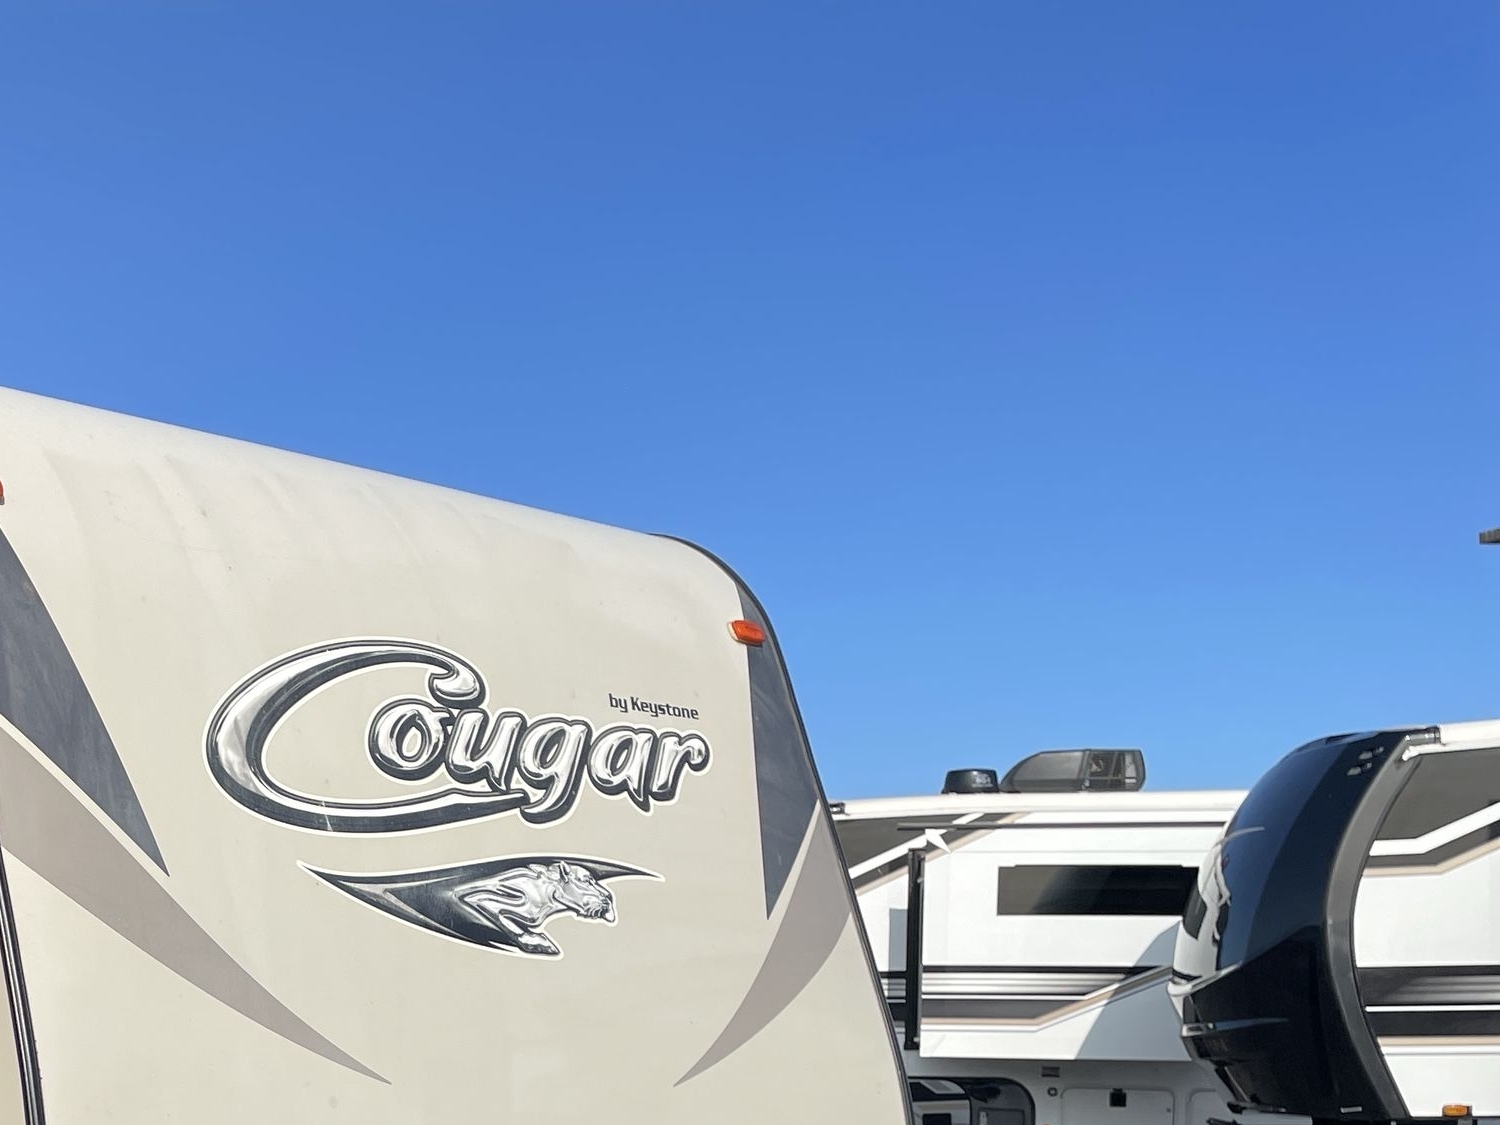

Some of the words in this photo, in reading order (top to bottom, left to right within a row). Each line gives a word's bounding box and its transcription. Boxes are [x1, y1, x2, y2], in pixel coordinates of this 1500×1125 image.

[205, 638, 712, 836] Cougar
[608, 693, 628, 713] by
[630, 696, 700, 720] Keystone
